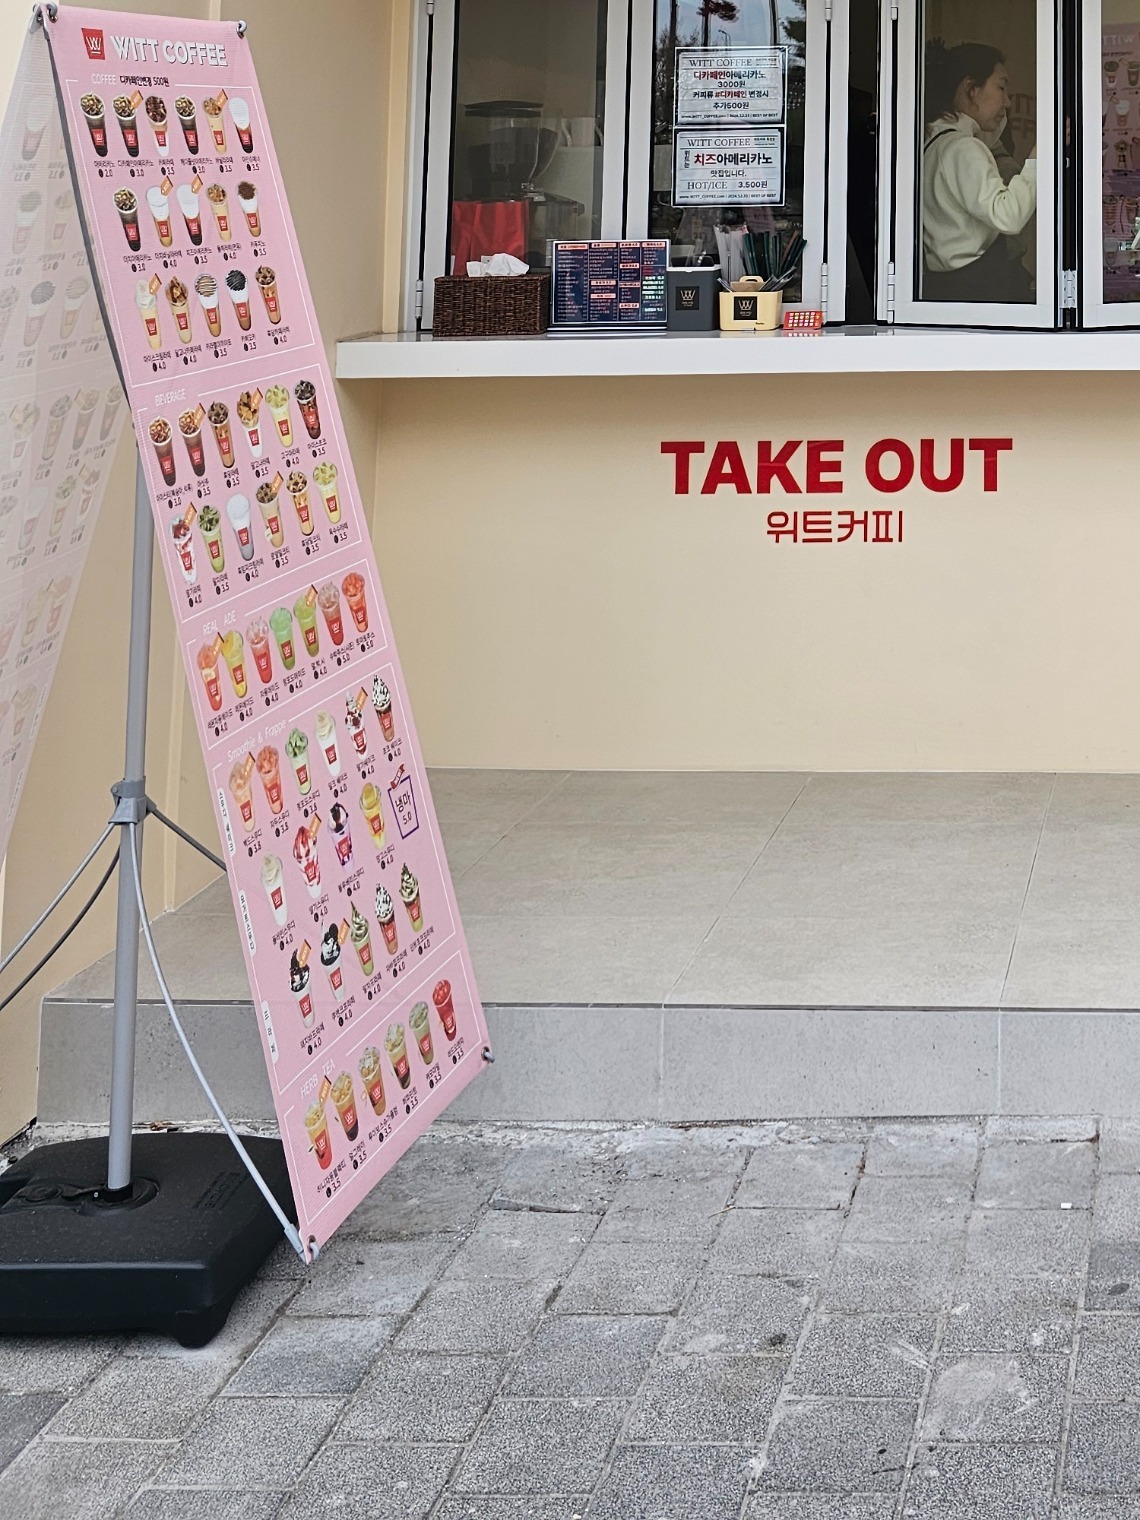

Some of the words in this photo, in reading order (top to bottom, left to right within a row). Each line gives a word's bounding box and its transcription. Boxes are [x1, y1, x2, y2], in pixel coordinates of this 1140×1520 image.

[110, 36, 161, 62] WITT
[160, 40, 229, 67] COFFEE
[687, 138, 712, 147] WITT
[714, 138, 751, 147] COFFEE
[694, 153, 773, 166] 치즈아메리카노
[660, 440, 844, 494] TAKE
[865, 438, 1013, 493] OUT
[766, 510, 903, 543] 위트커피
[394, 789, 412, 818] 냉마
